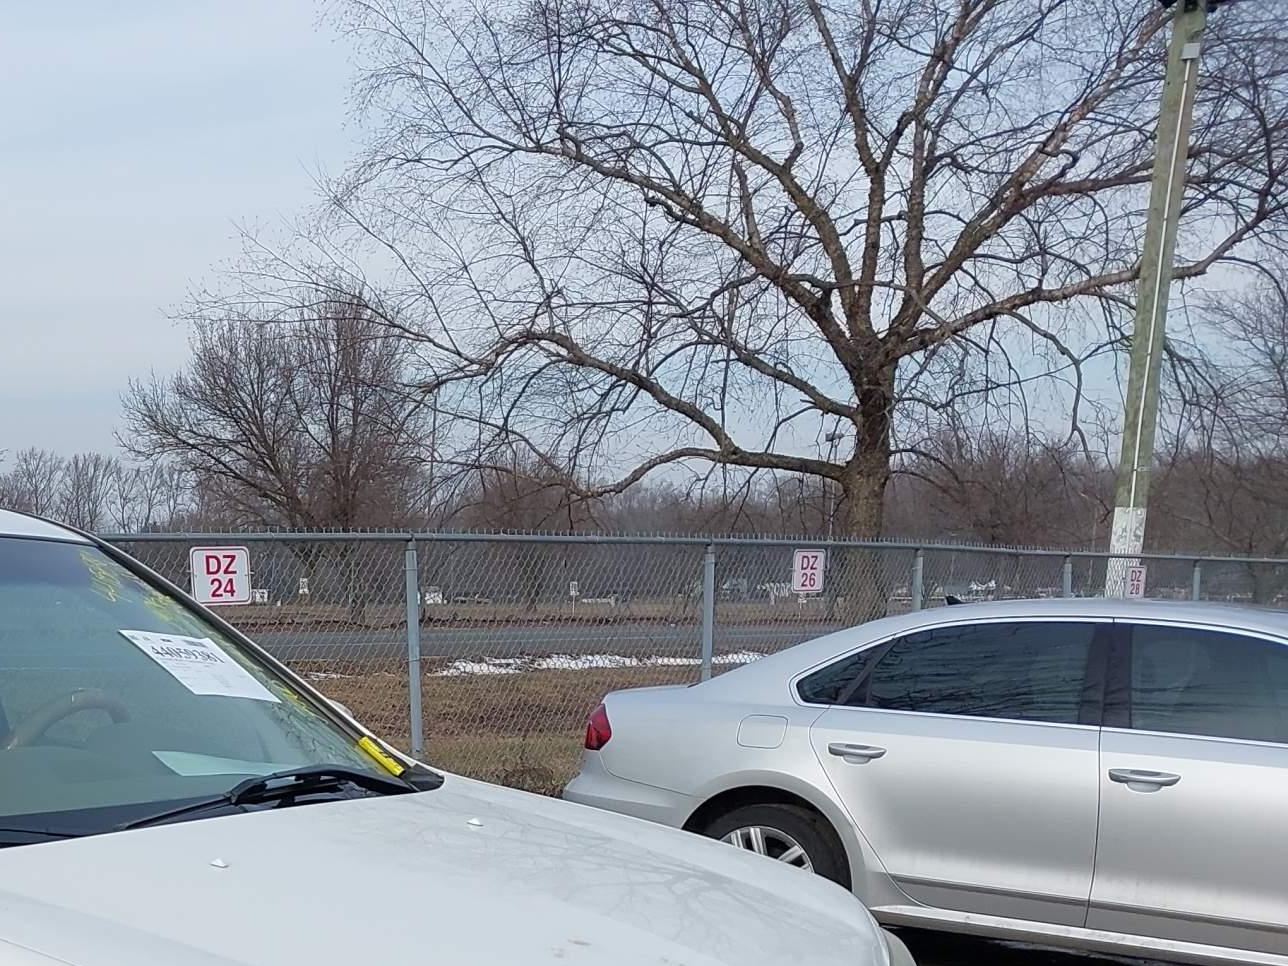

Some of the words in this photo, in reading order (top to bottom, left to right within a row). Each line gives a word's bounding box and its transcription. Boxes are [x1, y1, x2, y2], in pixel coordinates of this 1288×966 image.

[205, 554, 237, 575] DZ
[800, 555, 819, 571] DZ
[800, 572, 817, 588] 26
[1130, 570, 1142, 582] DZ
[210, 577, 236, 598] 24
[151, 645, 225, 664] 44059381
